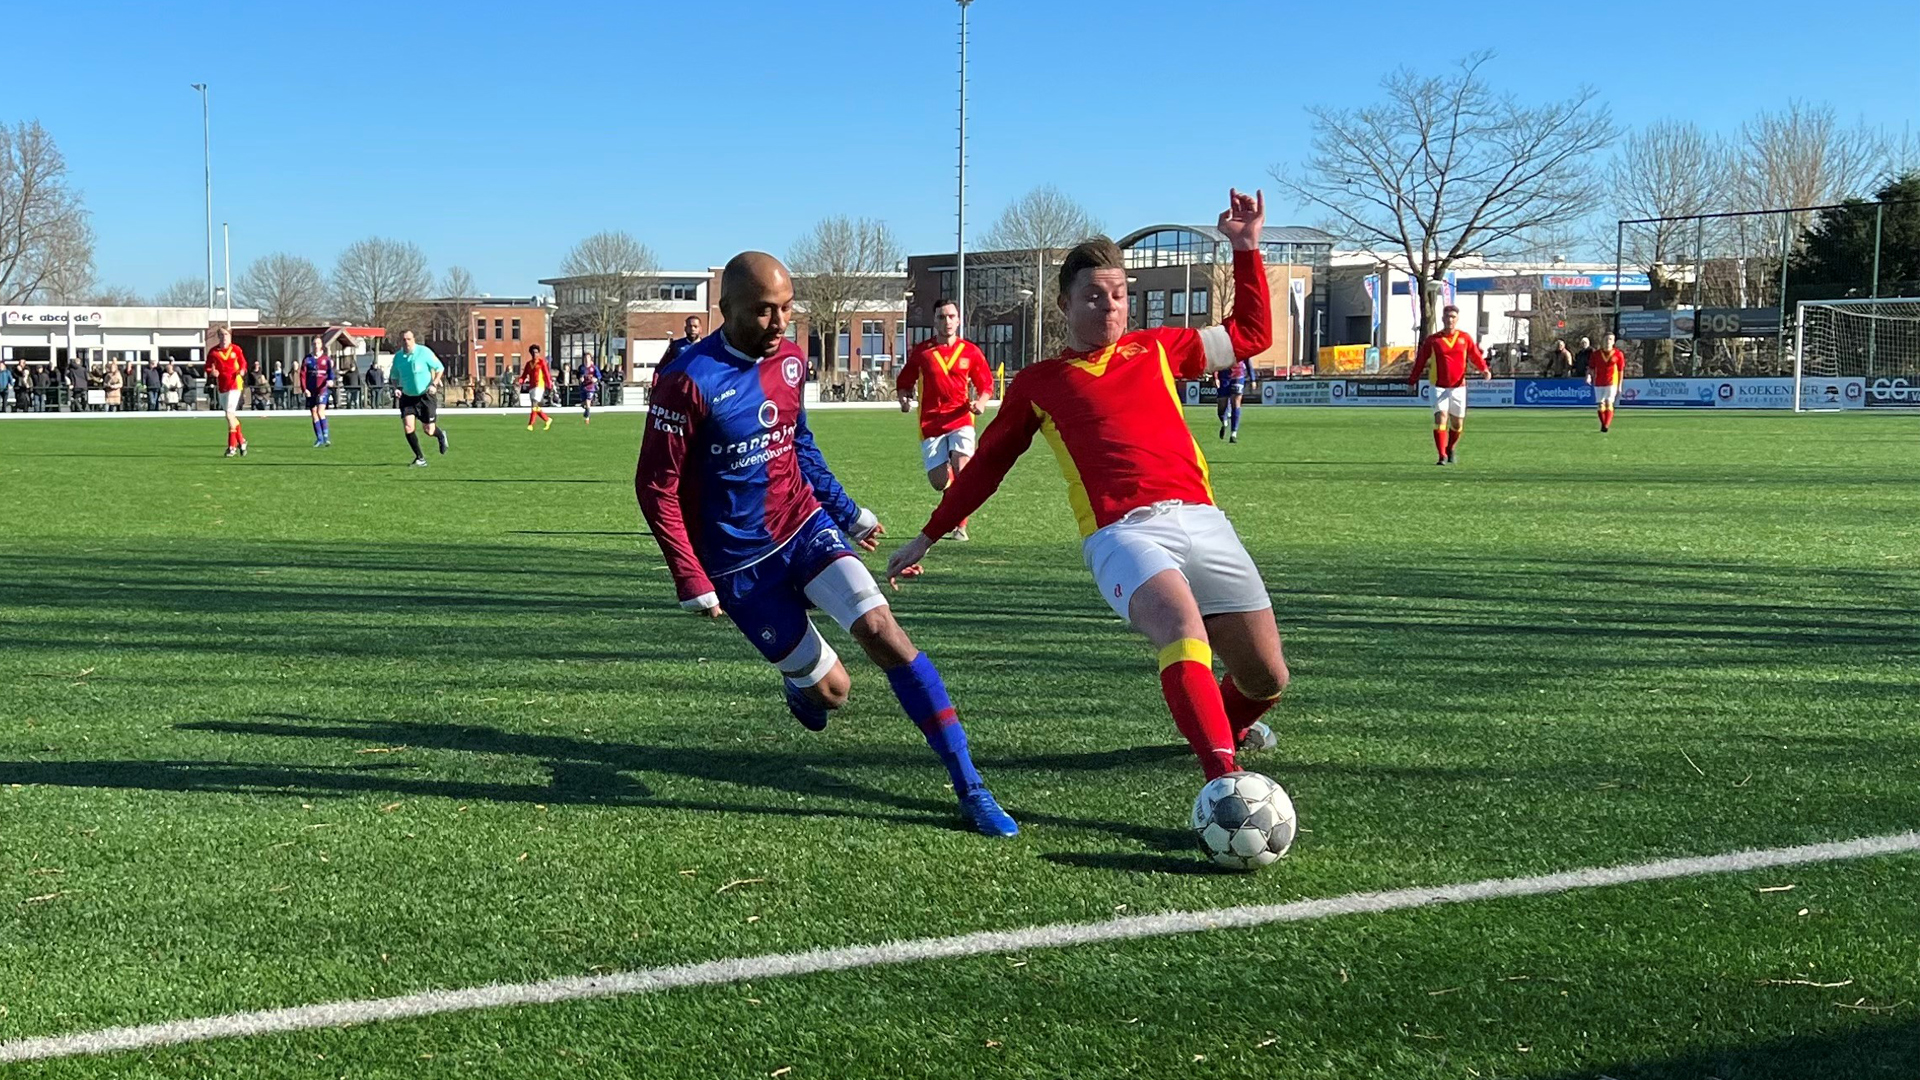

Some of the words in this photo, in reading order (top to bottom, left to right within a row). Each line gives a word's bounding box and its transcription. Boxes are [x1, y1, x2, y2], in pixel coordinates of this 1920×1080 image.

[1548, 276, 1592, 287] TAMOIL
[39, 313, 89, 322] abcode
[1699, 313, 1740, 333] BOS
[1538, 386, 1592, 400] voetbaltrips
